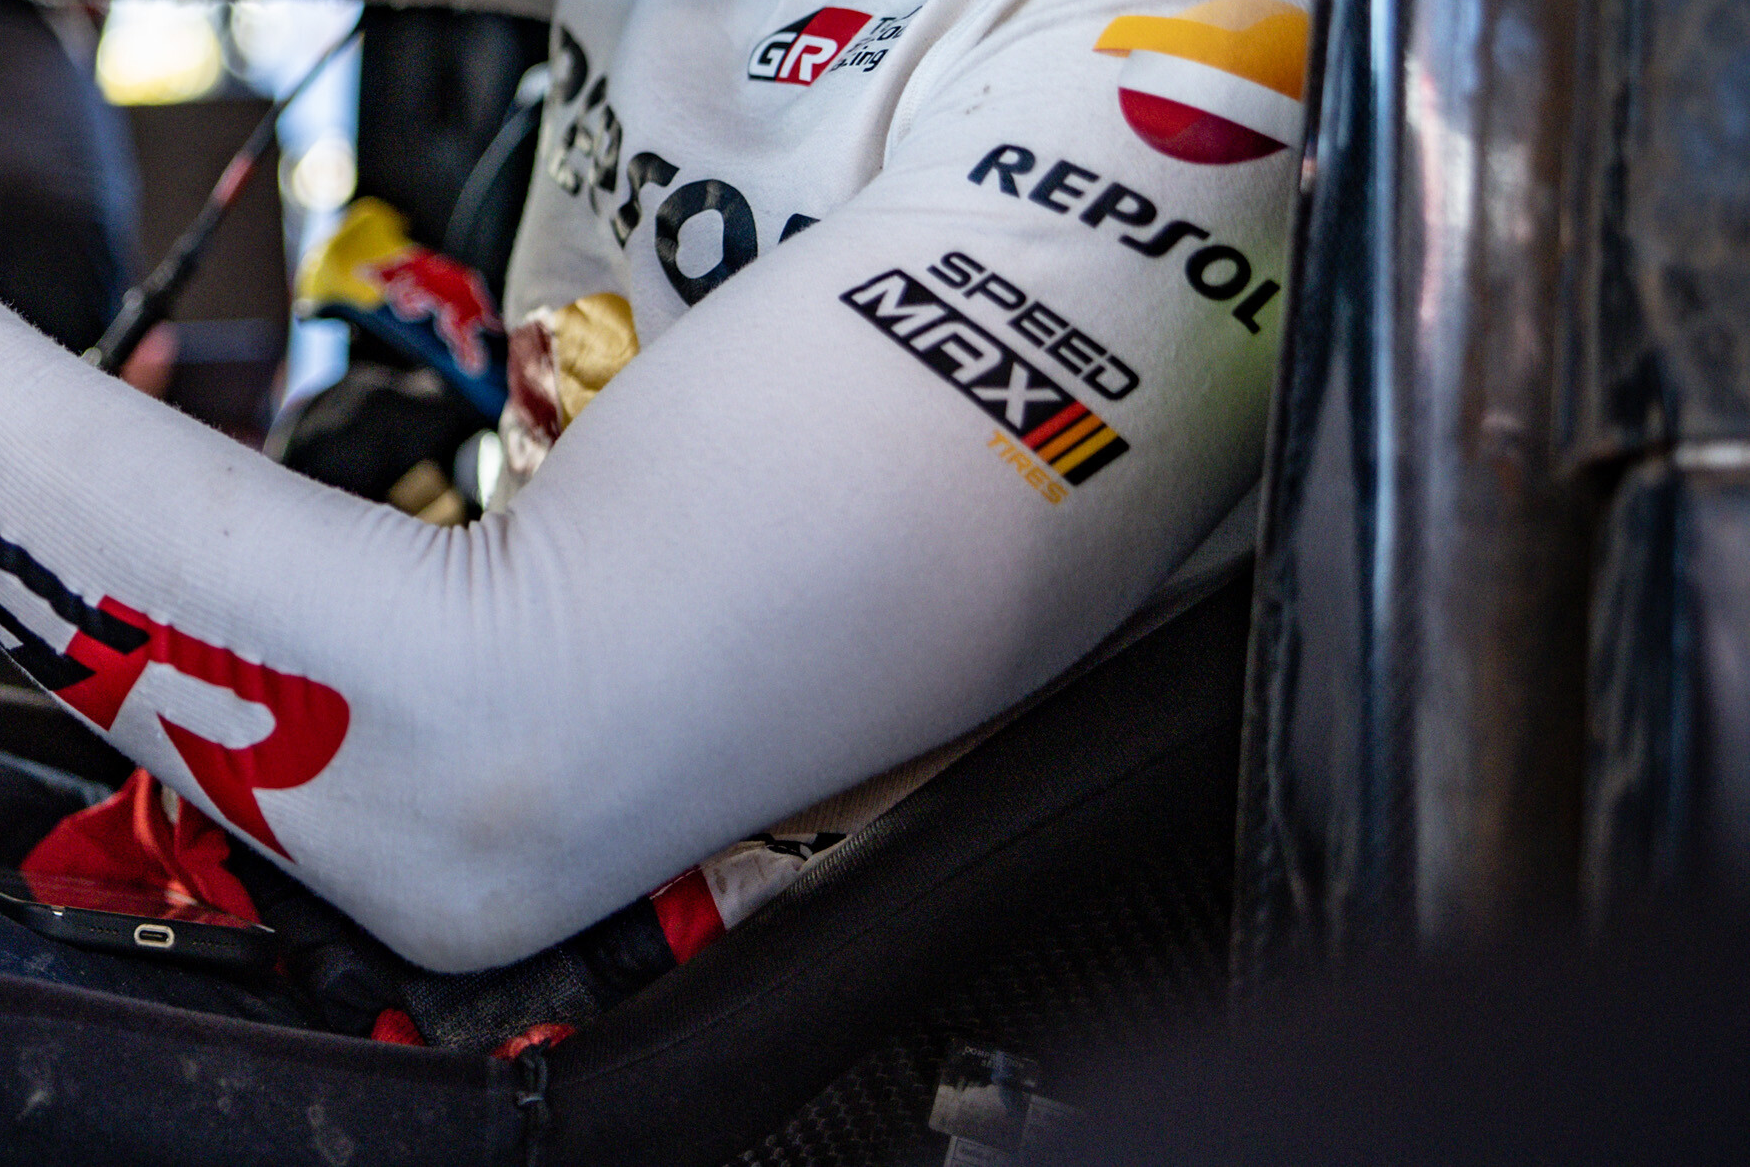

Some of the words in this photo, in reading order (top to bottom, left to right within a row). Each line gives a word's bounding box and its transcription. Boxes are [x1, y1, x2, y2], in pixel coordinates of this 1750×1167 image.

[750, 32, 838, 83] GR
[967, 143, 1281, 335] REPSOL
[855, 270, 1064, 431] MAX
[926, 250, 1140, 402] SPEED
[986, 430, 1070, 506] TIRES
